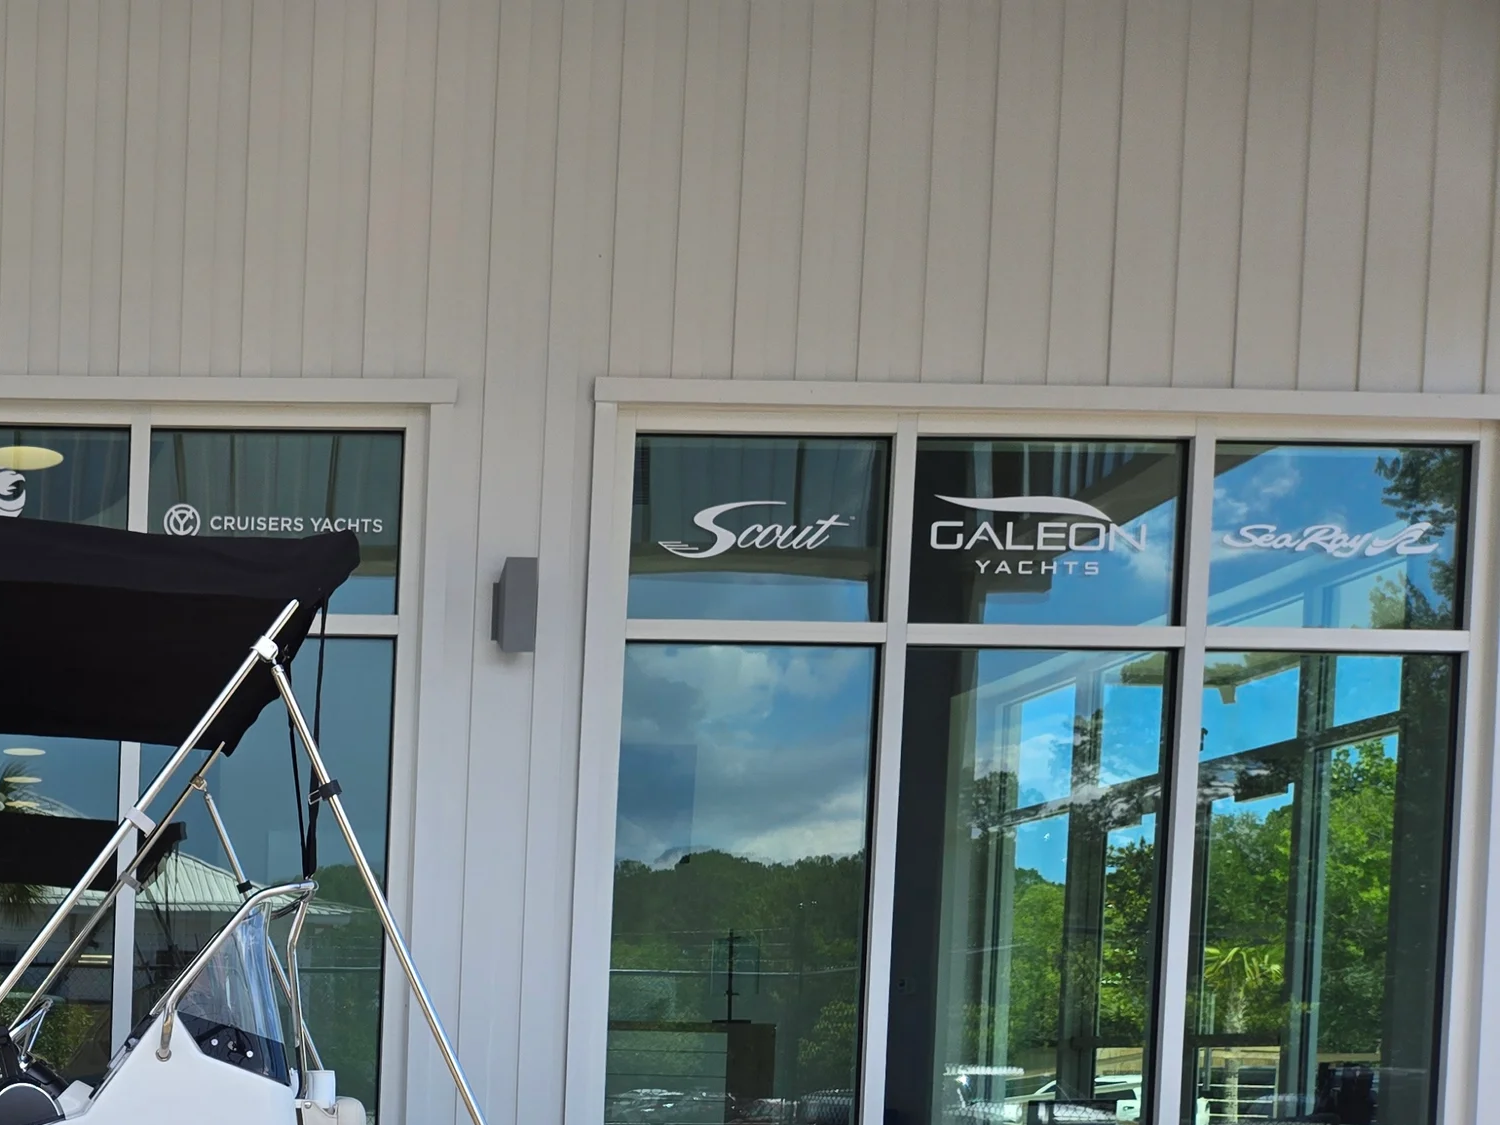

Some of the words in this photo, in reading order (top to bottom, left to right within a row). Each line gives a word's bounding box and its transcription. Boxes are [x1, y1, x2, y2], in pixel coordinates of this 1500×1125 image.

[210, 516, 304, 532] CRUISERS
[310, 517, 383, 533] YACHTS
[657, 500, 850, 559] Scout
[930, 521, 1147, 552] GALEON
[1223, 524, 1298, 549] Sea
[1295, 524, 1373, 558] Ray
[975, 559, 1099, 576] YACHTS
